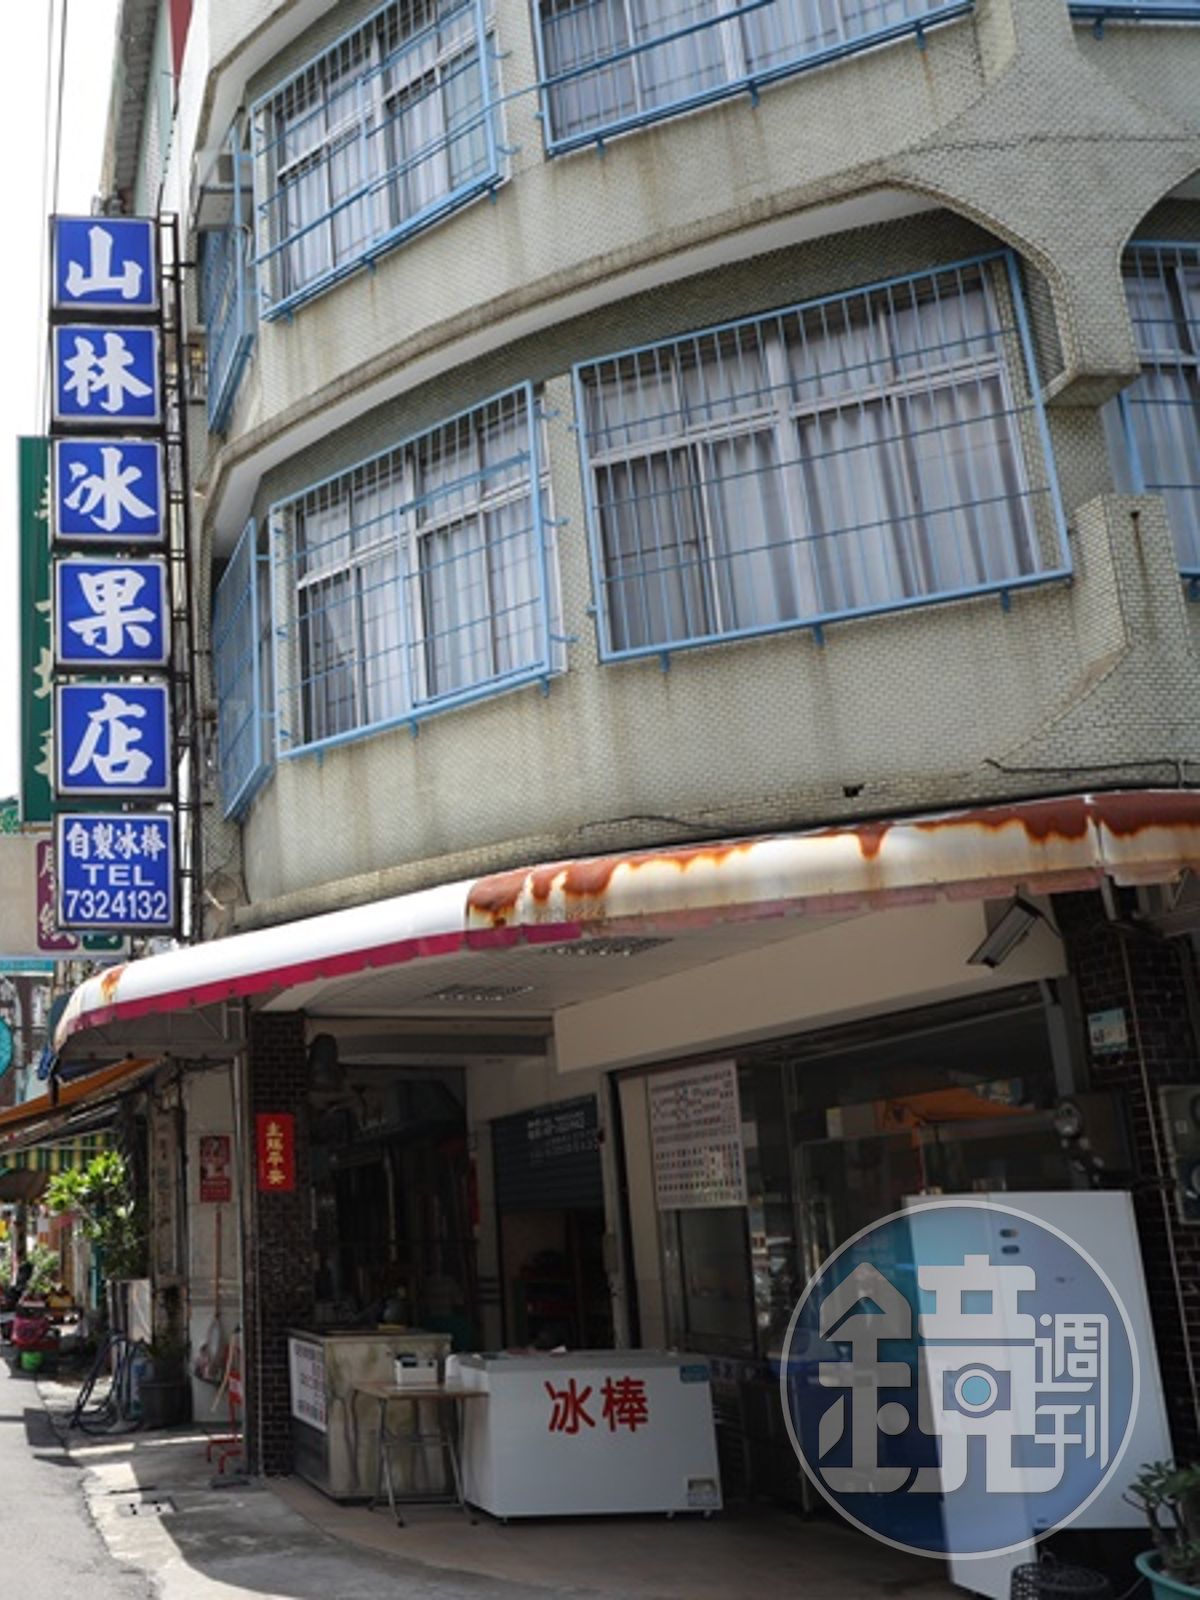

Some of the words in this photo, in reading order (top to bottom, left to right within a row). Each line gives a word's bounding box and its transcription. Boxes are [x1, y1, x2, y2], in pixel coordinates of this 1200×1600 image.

[63, 225, 158, 786] 山林冰果店
[65, 821, 168, 861] 自製冰棒
[82, 864, 156, 887] TEL
[65, 889, 168, 920] 7324132
[544, 1376, 650, 1436] 冰棒
